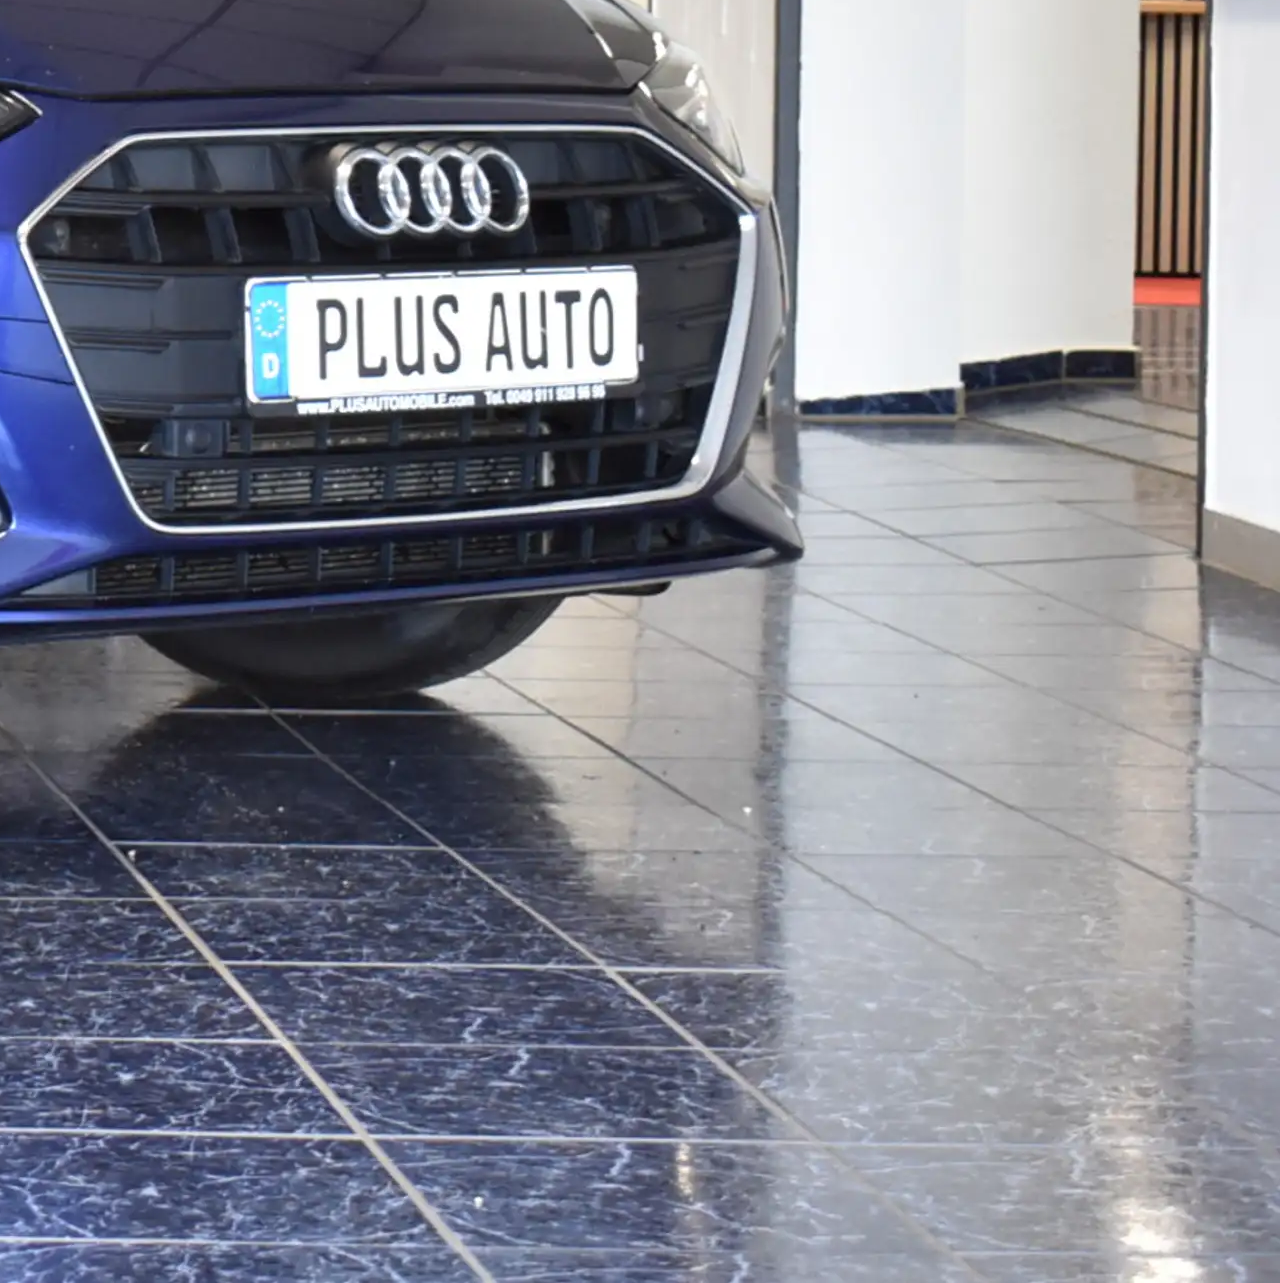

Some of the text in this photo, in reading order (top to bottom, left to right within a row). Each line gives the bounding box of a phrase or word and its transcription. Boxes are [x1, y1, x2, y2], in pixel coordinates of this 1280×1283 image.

[316, 288, 615, 381] PLUS AUTO
[261, 352, 280, 379] D
